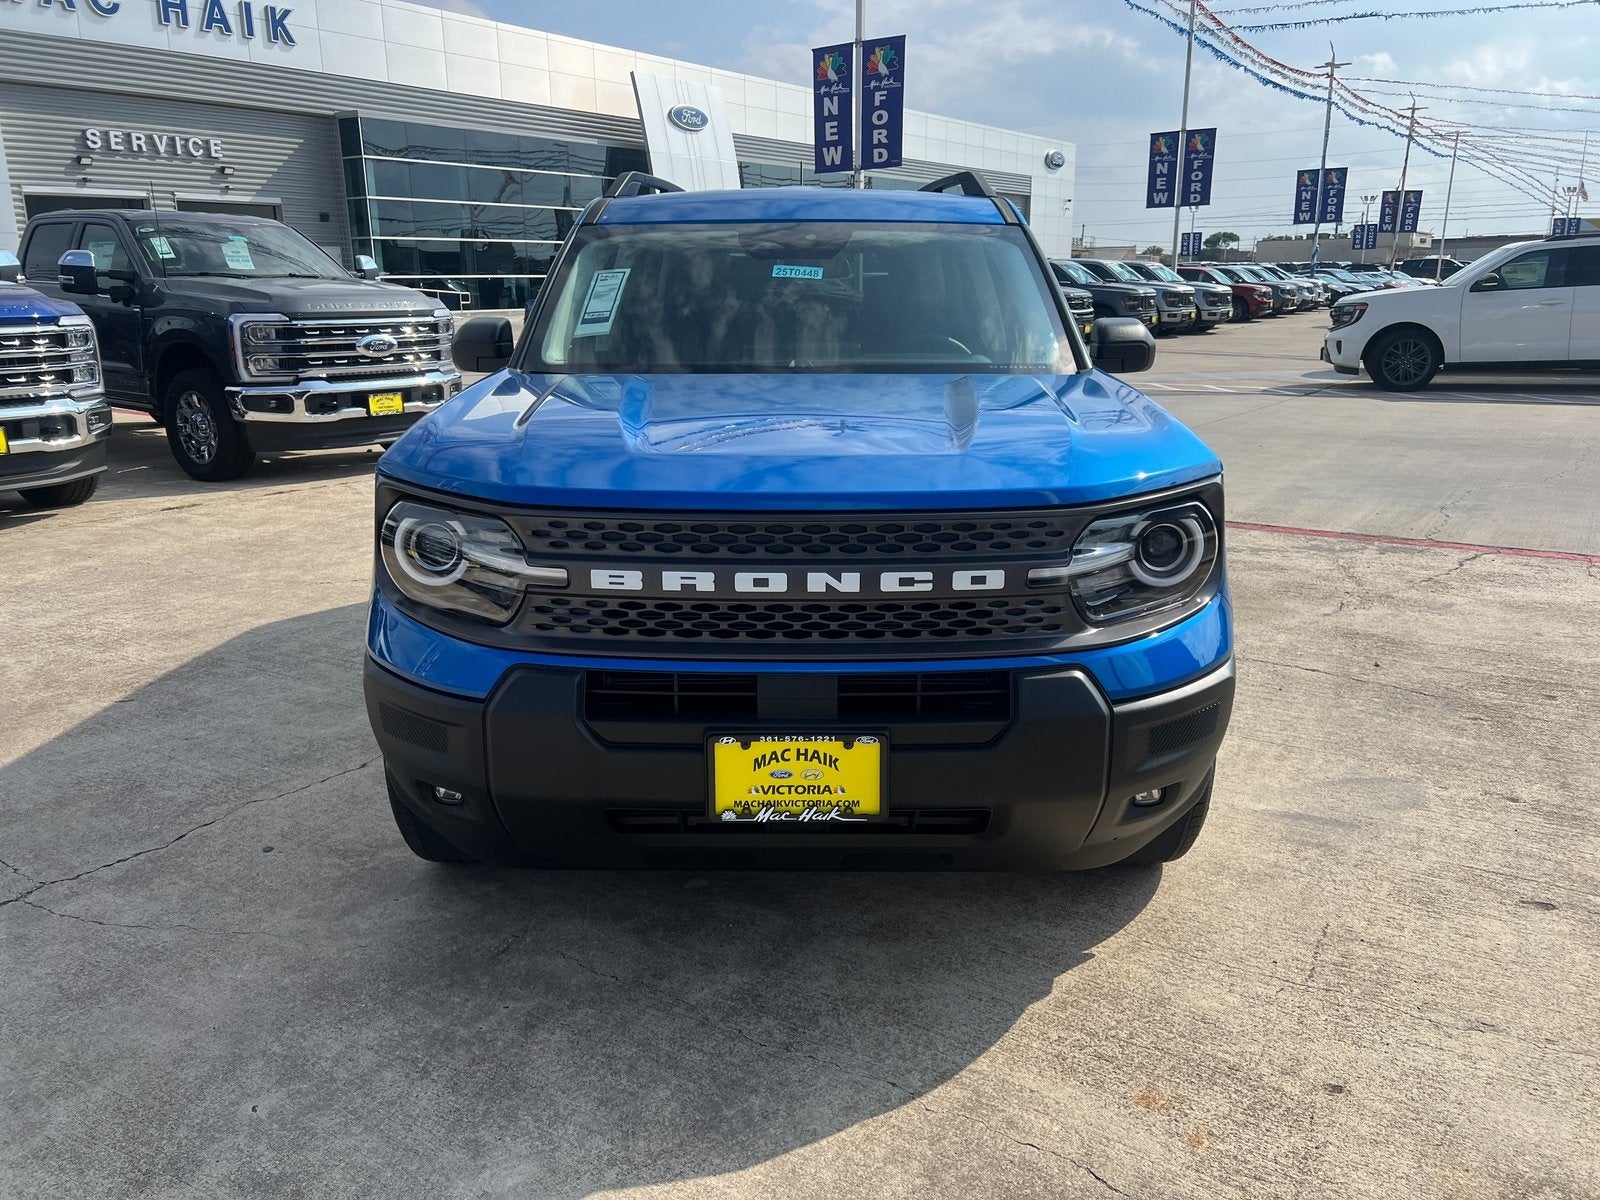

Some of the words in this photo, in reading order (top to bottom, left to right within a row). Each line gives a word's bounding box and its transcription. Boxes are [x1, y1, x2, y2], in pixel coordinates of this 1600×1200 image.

[156, 0, 296, 46] HAIK
[822, 96, 842, 166] NEW
[872, 90, 889, 163] FORD
[85, 128, 224, 159] SERVICE
[1153, 162, 1168, 204] NEW
[1189, 160, 1203, 203] FORD
[1299, 191, 1311, 221] NEW
[1326, 189, 1337, 220] FORD
[1382, 207, 1393, 231] NEW
[1404, 206, 1414, 231] FORD
[775, 267, 819, 278] 25T0448
[590, 569, 1005, 593] BRONCO
[753, 748, 791, 772] MAC
[796, 748, 840, 772] HAIK
[760, 785, 833, 795] VICTORIA
[754, 806, 793, 823] Mac
[797, 806, 845, 823] Haik
